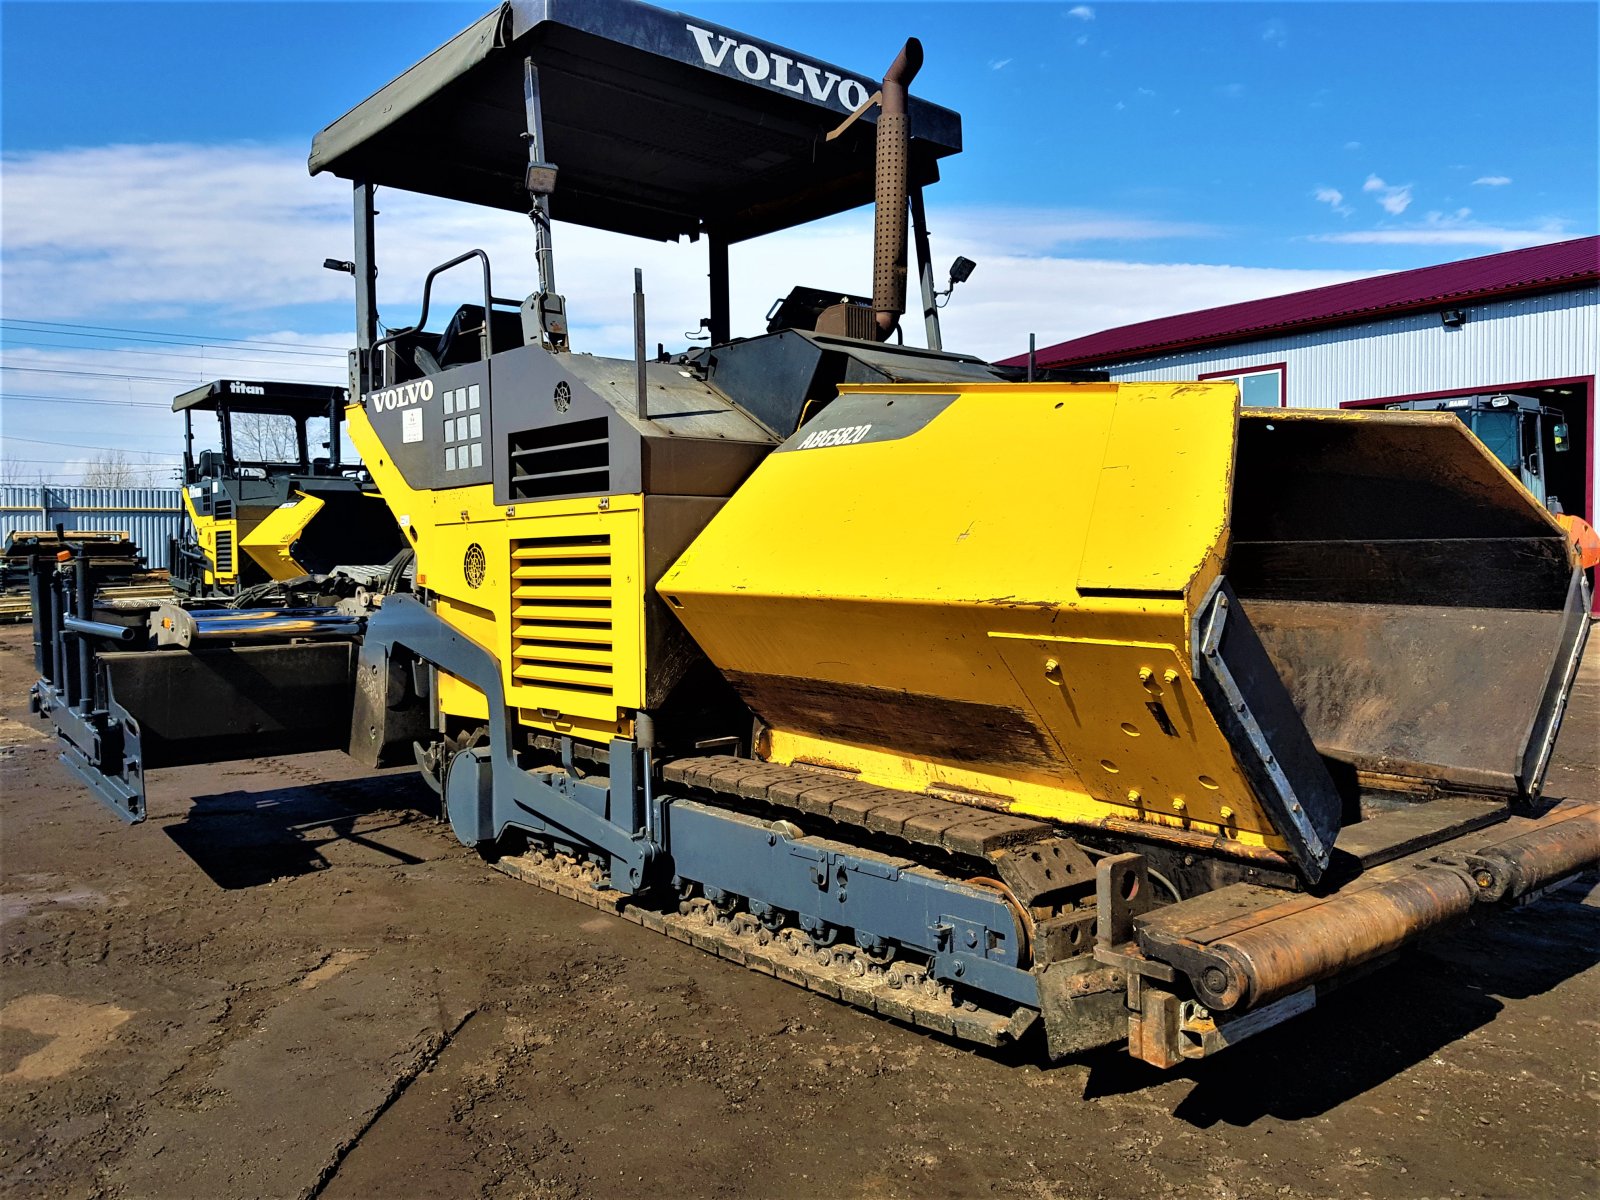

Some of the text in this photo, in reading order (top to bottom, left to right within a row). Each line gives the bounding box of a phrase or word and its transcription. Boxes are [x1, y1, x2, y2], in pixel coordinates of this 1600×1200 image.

[686, 24, 869, 112] VOLVO
[230, 381, 264, 395] titan
[371, 379, 434, 413] VOLVO
[797, 424, 872, 449] ABG5820
